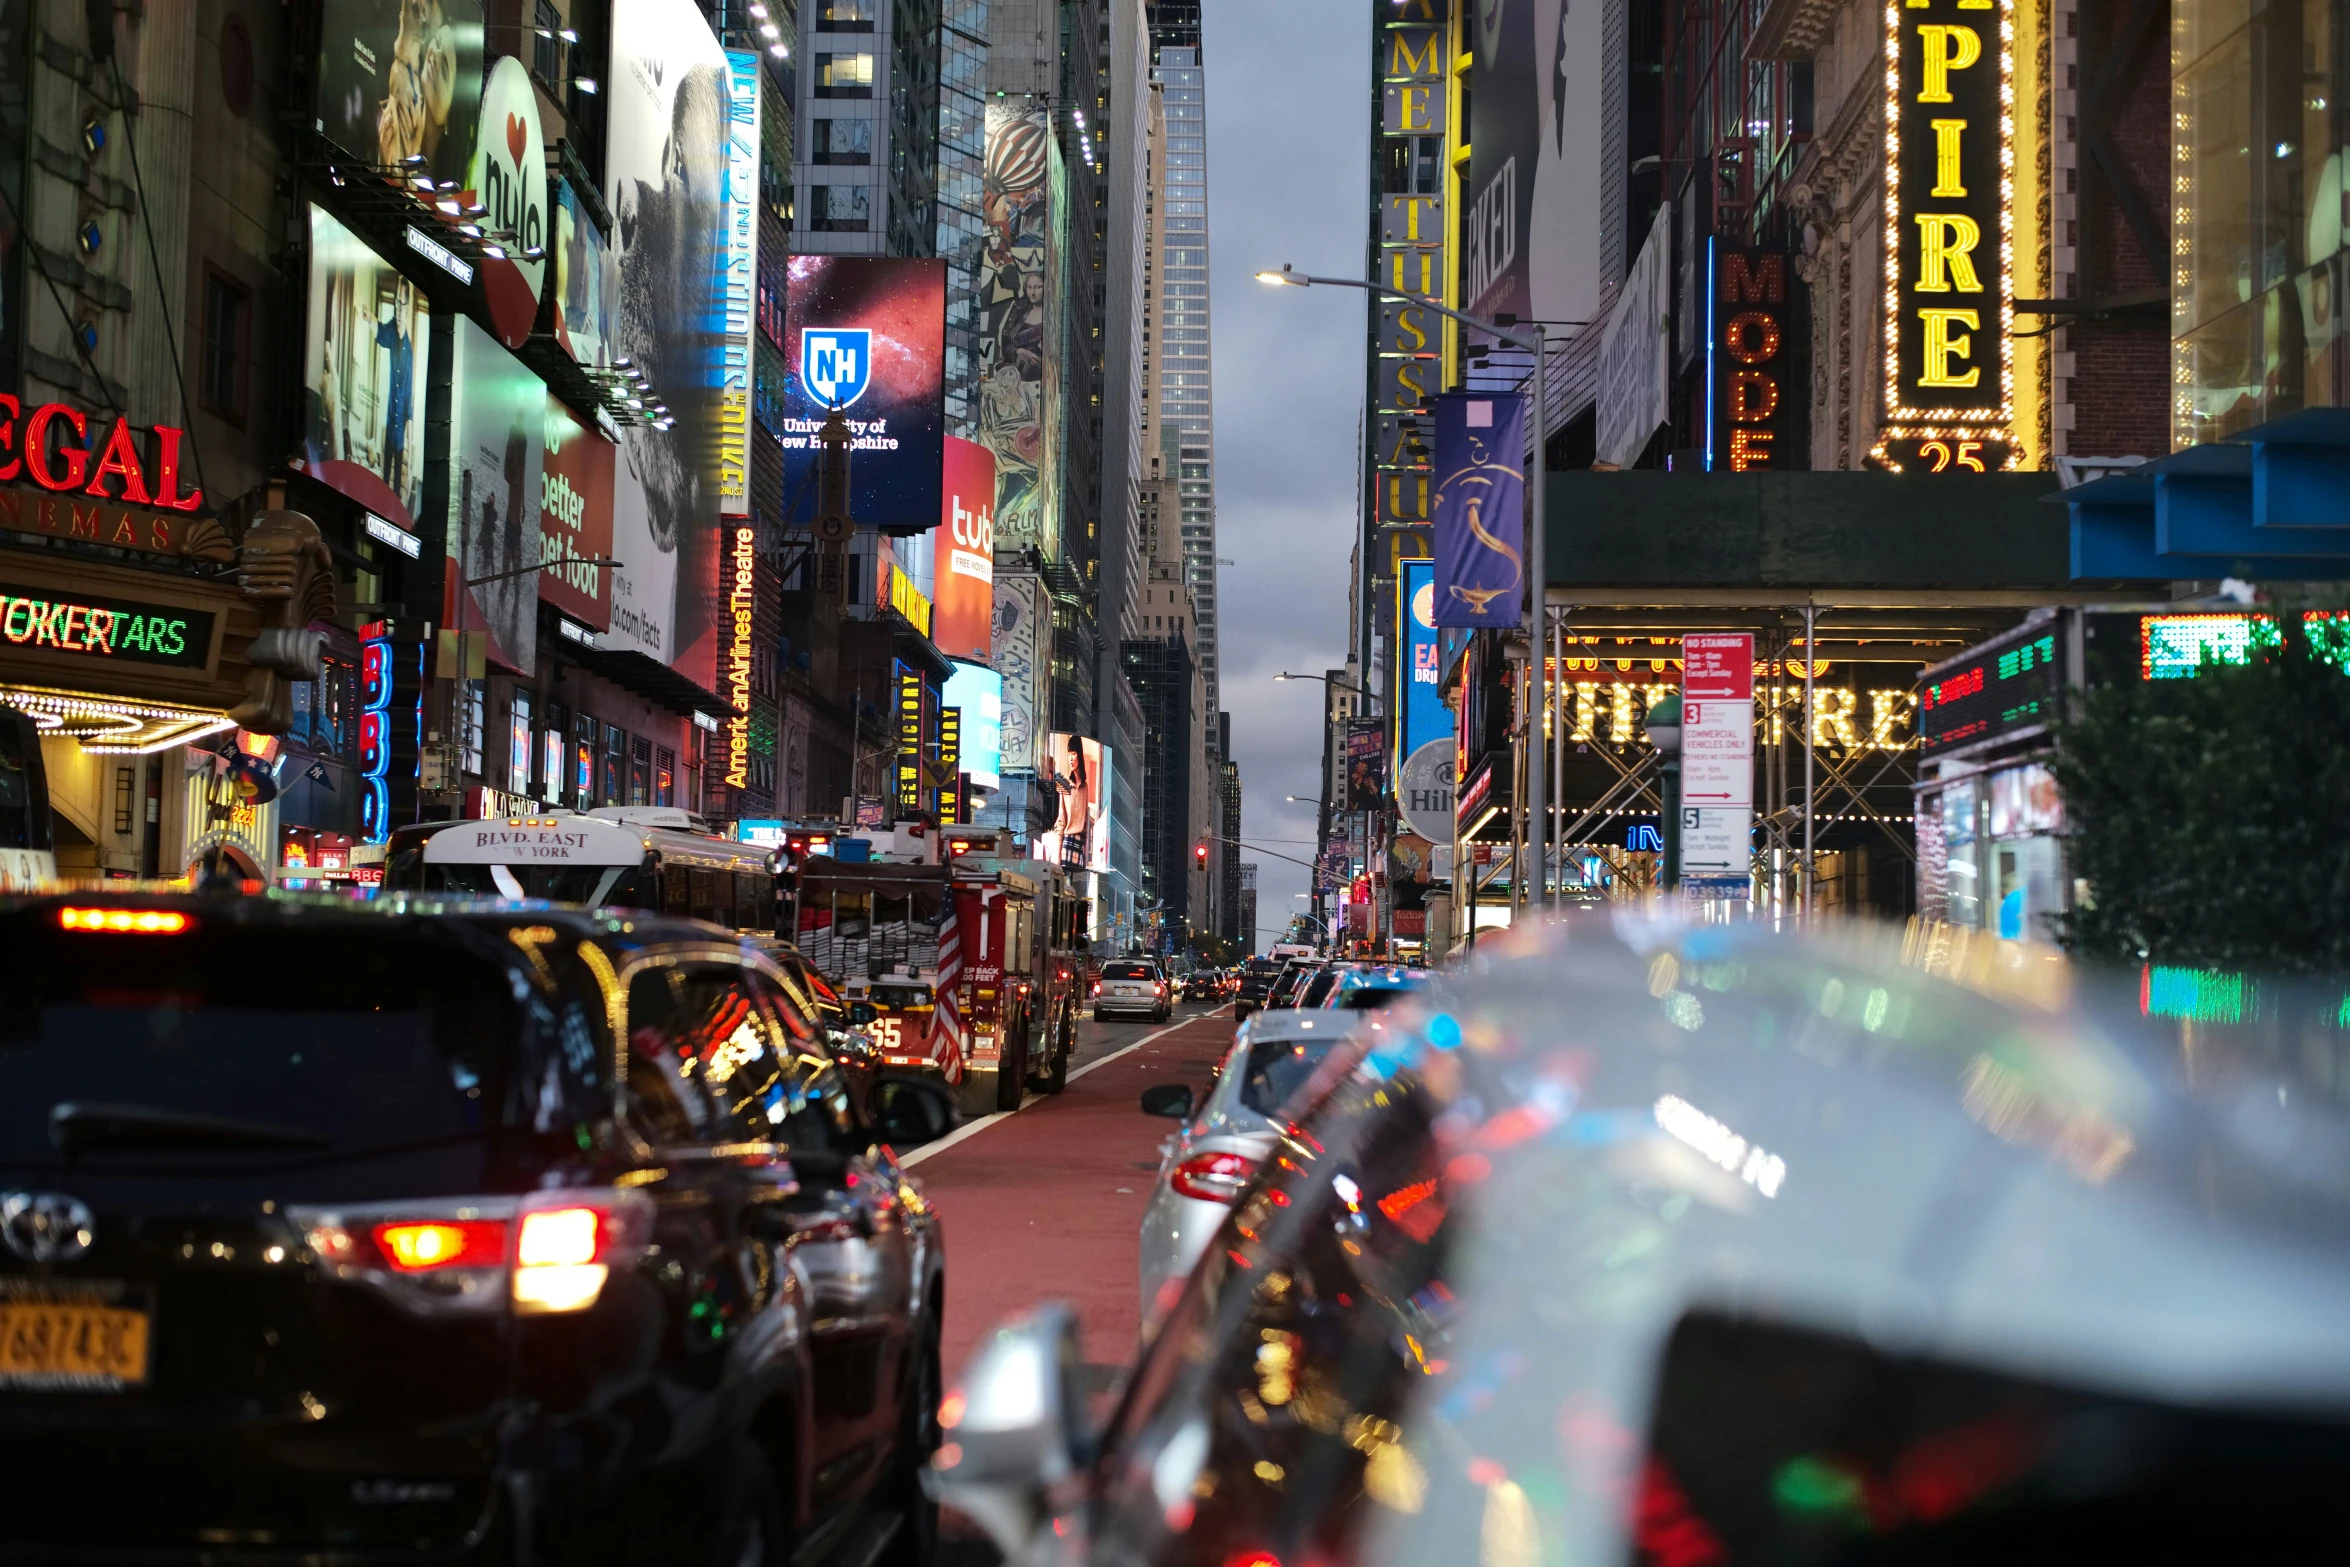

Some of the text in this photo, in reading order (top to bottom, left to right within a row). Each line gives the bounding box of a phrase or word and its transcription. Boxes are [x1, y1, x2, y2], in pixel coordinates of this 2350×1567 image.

[1905, 0, 1994, 387] PIRE
[486, 151, 541, 253] nulo
[817, 348, 857, 383] NH
[870, 418, 887, 433] of
[773, 435, 807, 449] ew
[566, 535, 599, 600] food
[1687, 638, 1700, 648] NO
[1700, 638, 1743, 649] STANDING
[1687, 669, 1732, 678] Except Sunday
[902, 675, 919, 755] VICTORY
[1687, 705, 1699, 724] 3
[1687, 730, 1738, 738] COMMERCIAL
[1687, 740, 1746, 749] VEHICLES ONLY
[1684, 809, 1698, 829] 5
[476, 832, 588, 848] BLVD. EAST
[531, 847, 570, 858] YORK
[324, 871, 350, 879] DALLAS
[975, 974, 995, 982] FEET
[976, 967, 999, 975] BACK
